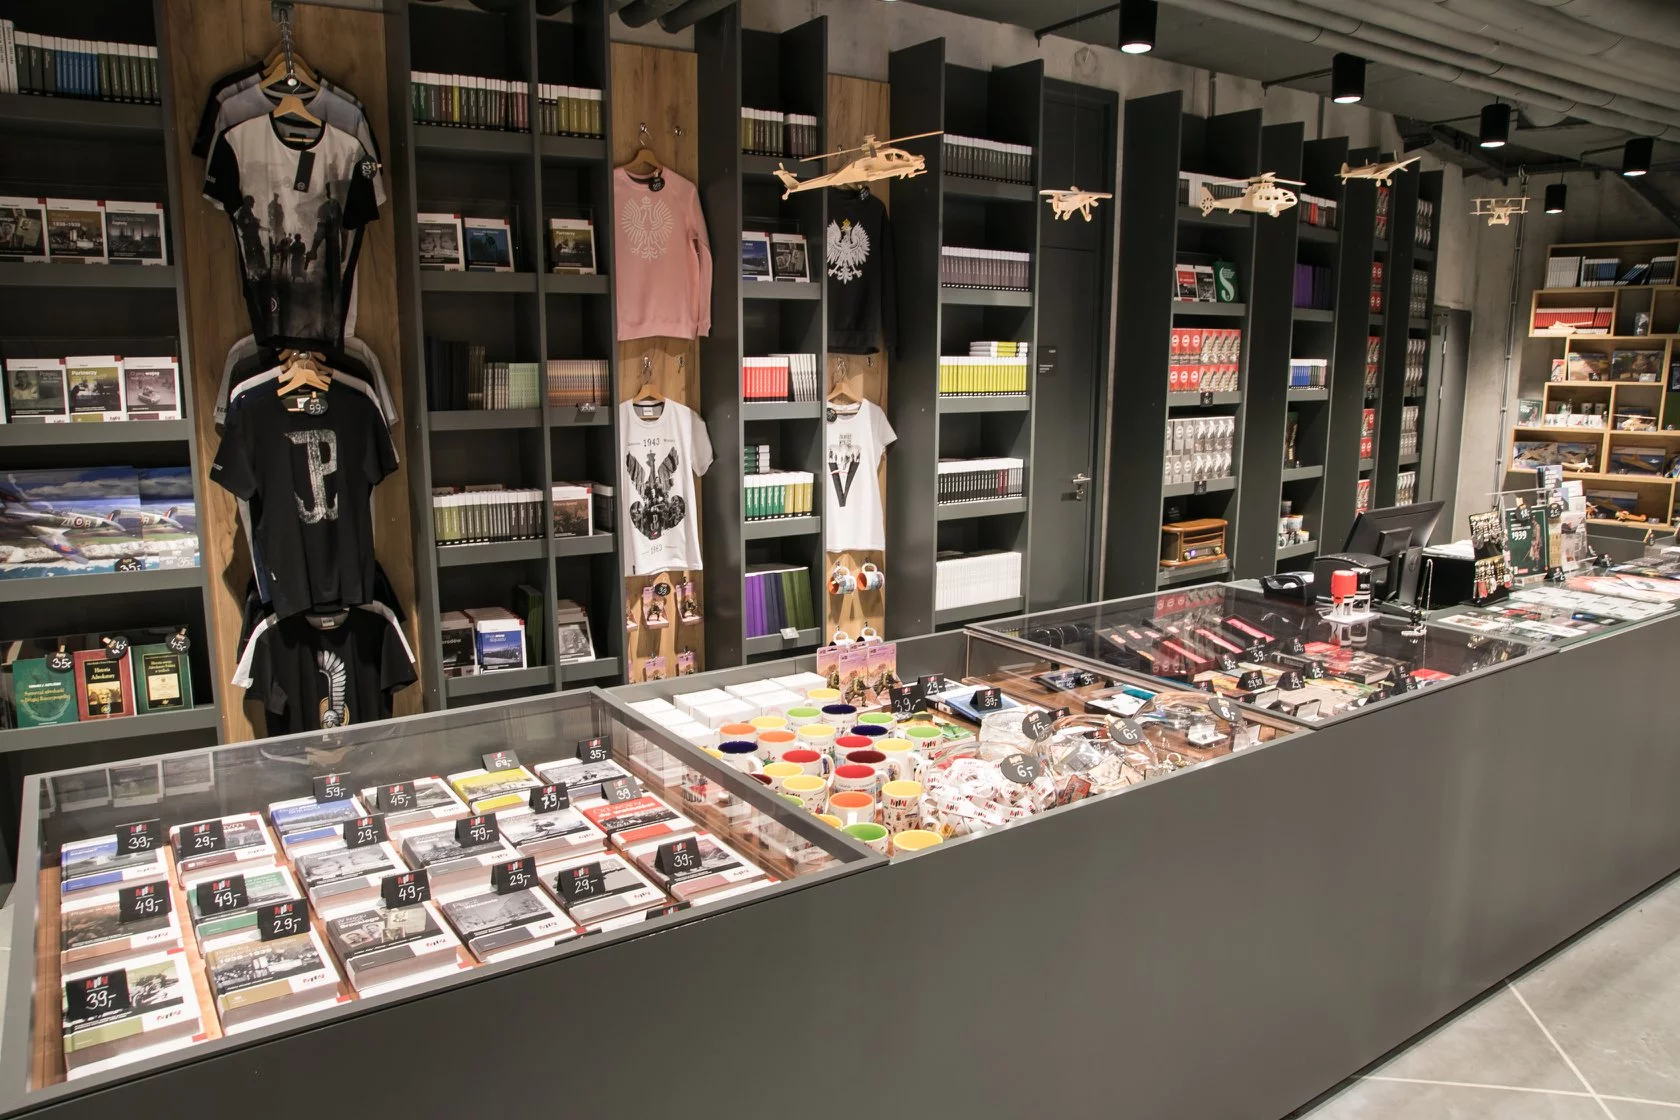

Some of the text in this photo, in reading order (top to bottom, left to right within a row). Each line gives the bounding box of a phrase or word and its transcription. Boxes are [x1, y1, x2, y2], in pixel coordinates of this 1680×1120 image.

[643, 438, 661, 447] 1943
[1511, 531, 1527, 541] 1939
[589, 749, 607, 760] 35,-
[1017, 765, 1034, 778] 6,-
[325, 787, 347, 798] 59,-
[390, 795, 412, 806] 45,-
[128, 833, 154, 849] 39,-
[194, 833, 218, 848] 29,-
[357, 830, 378, 843] 29,-
[470, 829, 494, 841] 79,-
[673, 853, 696, 868] 39,-
[509, 874, 531, 887] 29,-
[574, 879, 599, 893] 29,-
[214, 892, 241, 907] 49,-
[398, 886, 425, 901] 49,-
[134, 899, 164, 914] 49,-
[273, 918, 302, 934] 29,-
[86, 990, 117, 1009] 39,-
